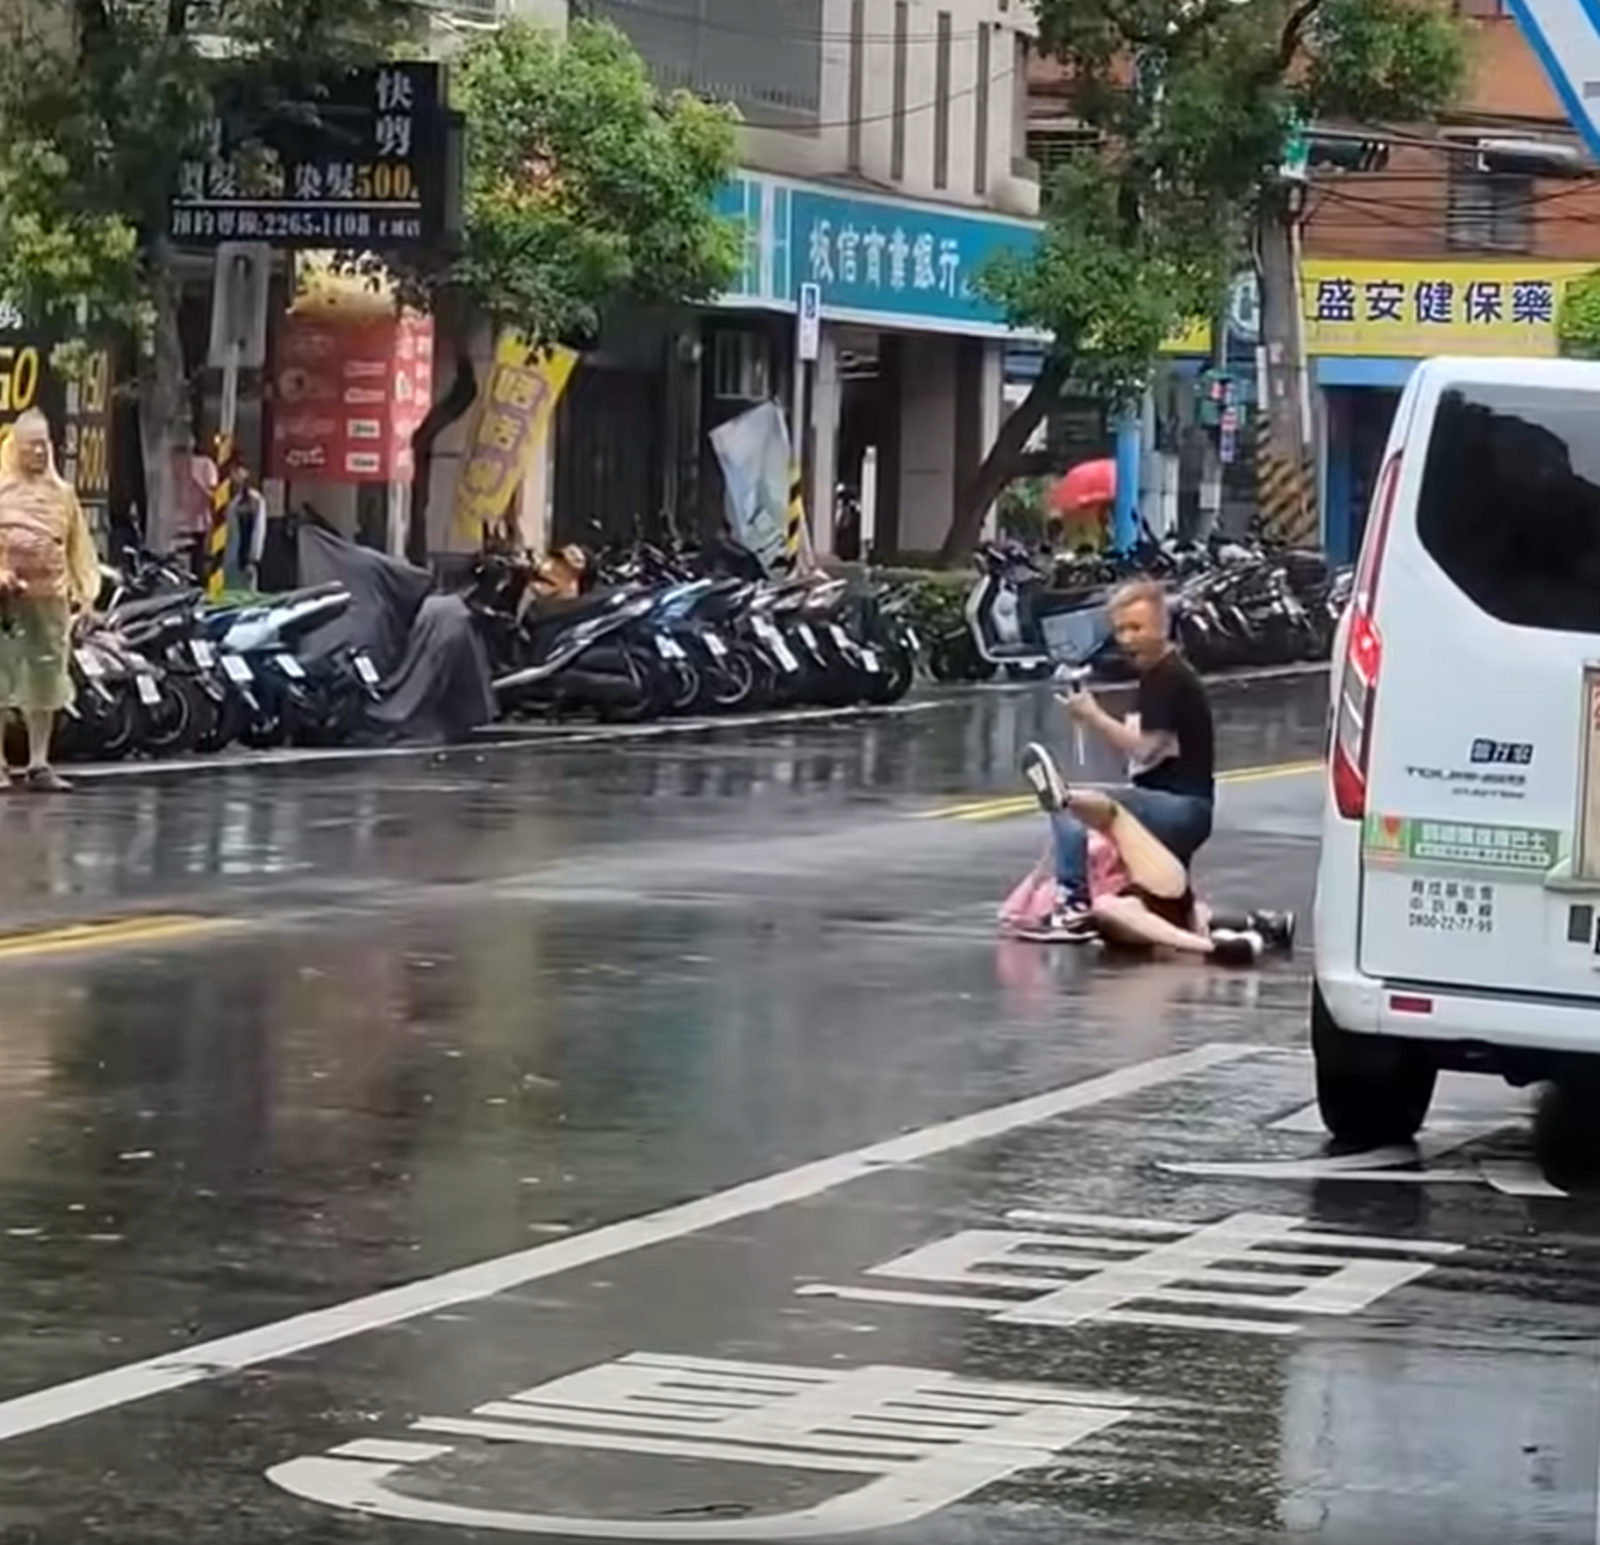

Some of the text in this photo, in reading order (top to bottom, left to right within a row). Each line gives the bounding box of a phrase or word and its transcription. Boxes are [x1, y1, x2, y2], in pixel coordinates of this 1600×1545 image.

[375, 70, 414, 157] 快剪
[808, 216, 960, 299] 板信商業銀行
[1317, 278, 1553, 325] 盛安健保藥
